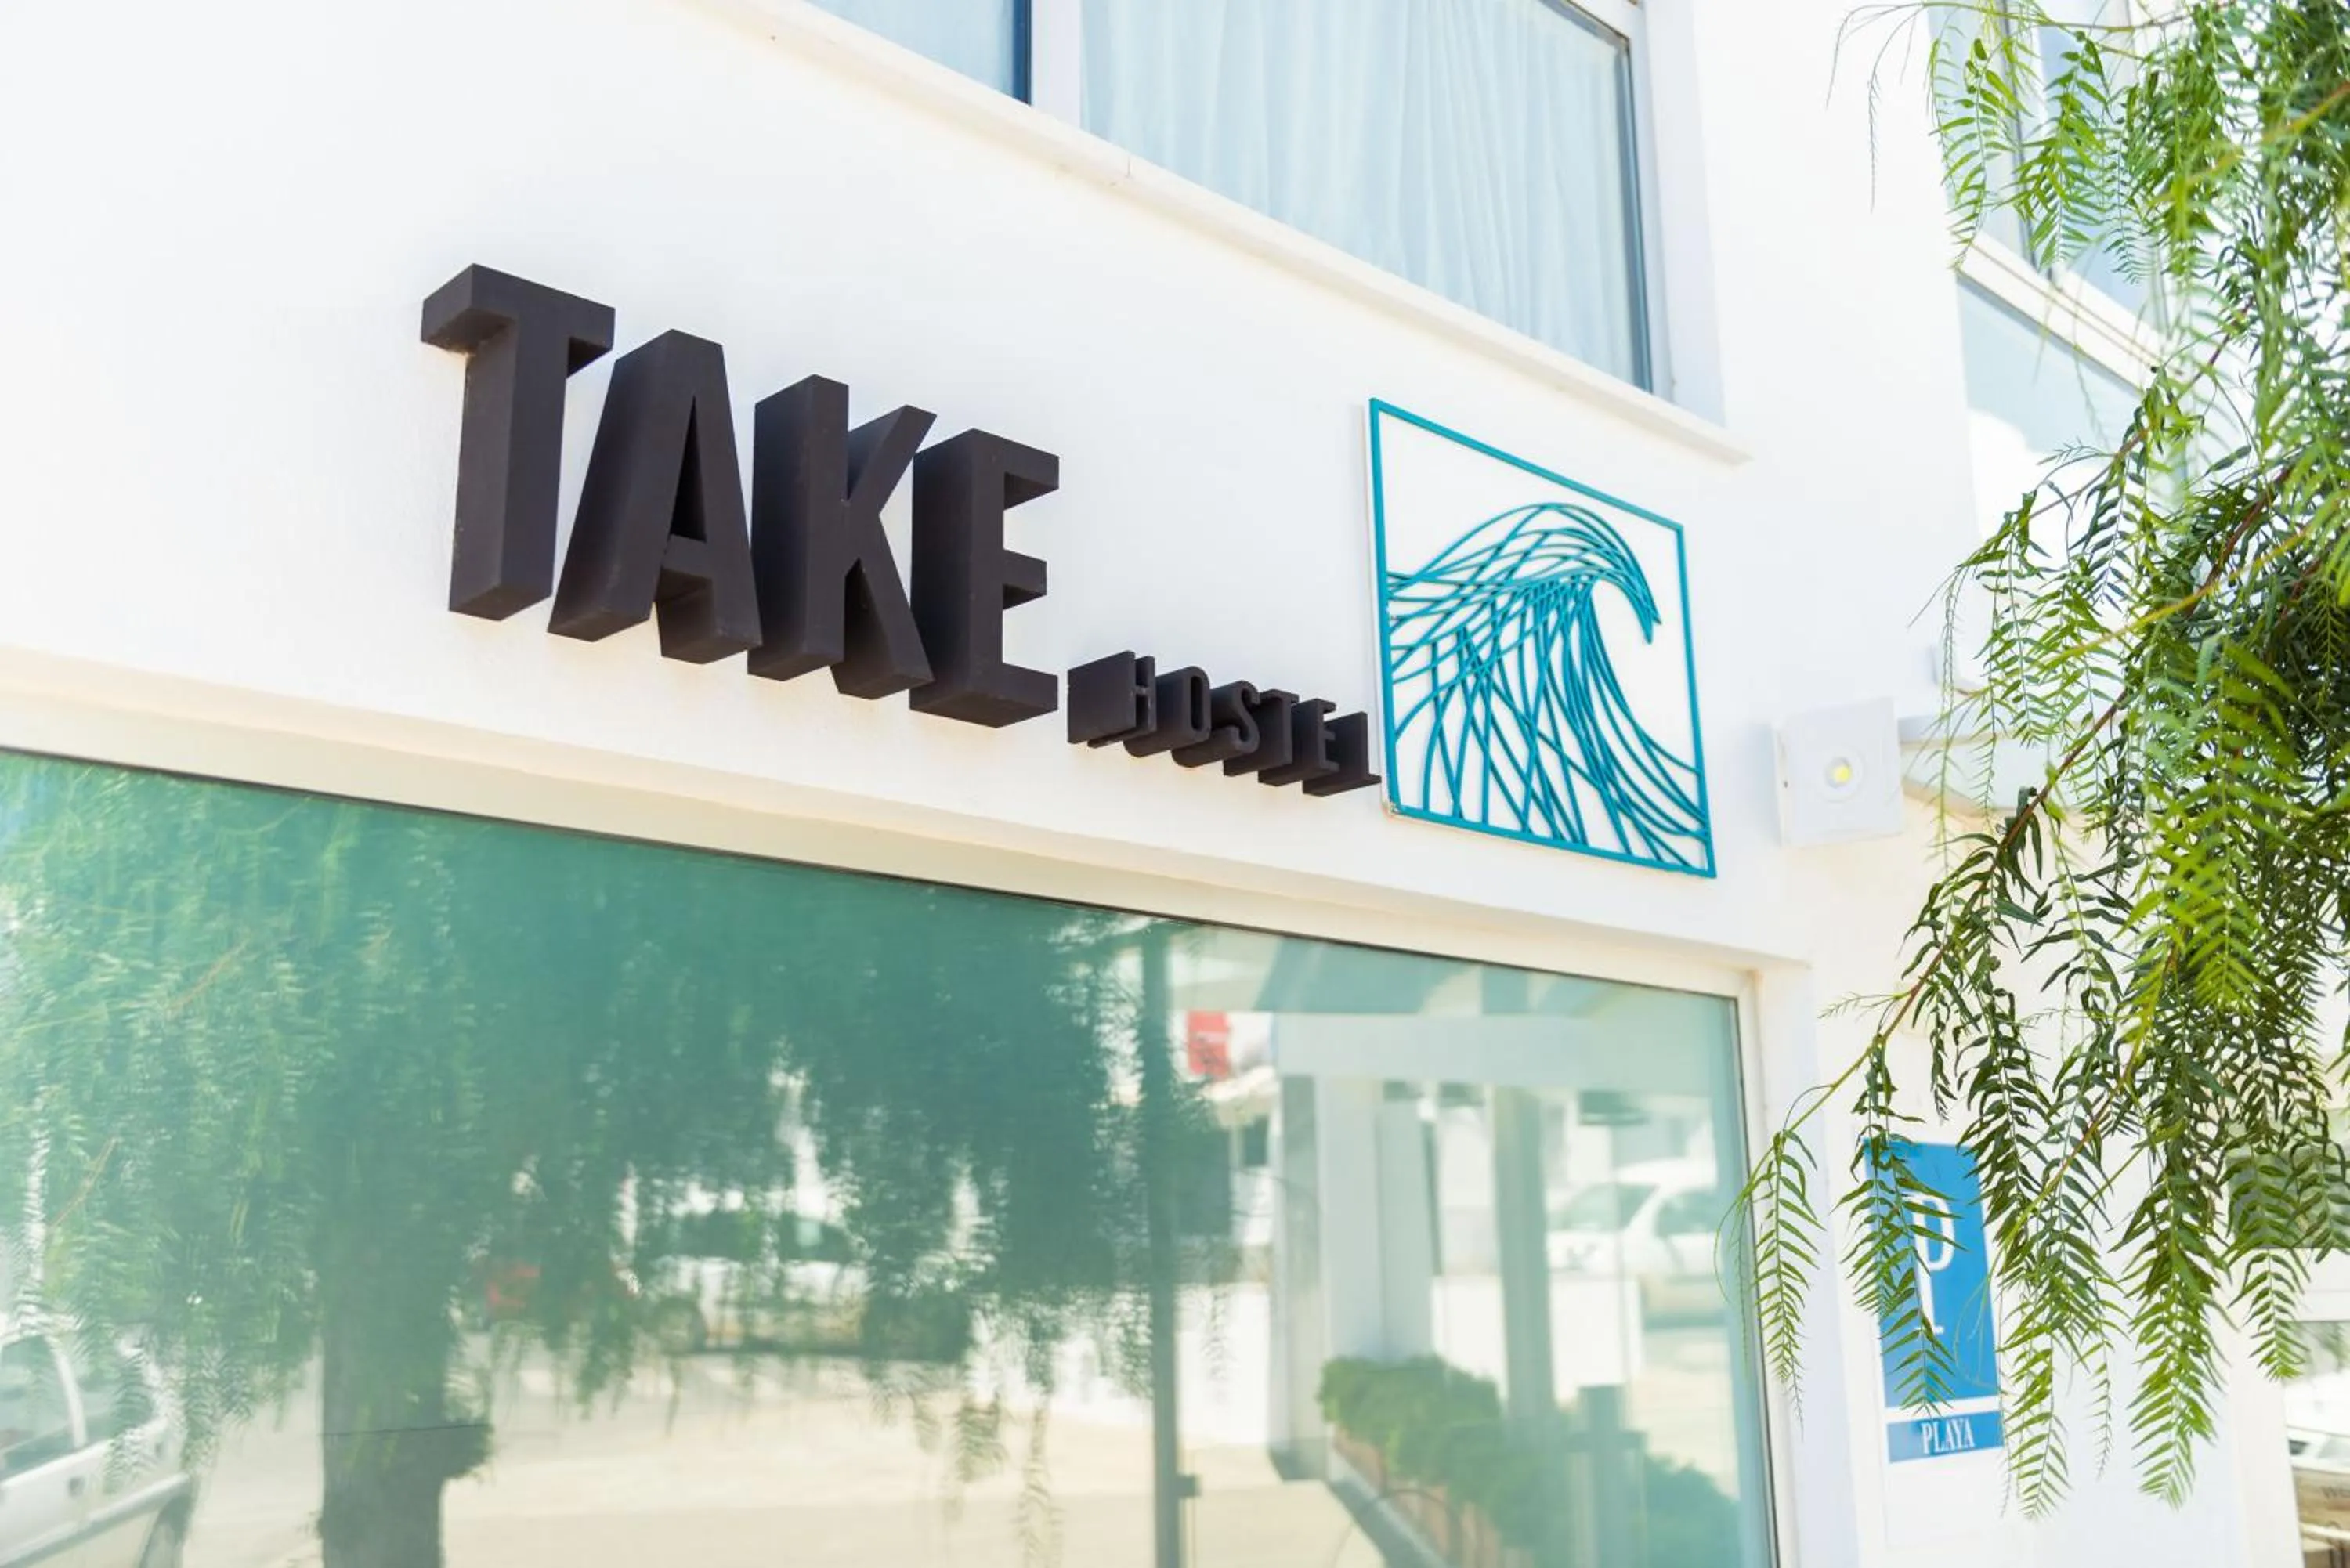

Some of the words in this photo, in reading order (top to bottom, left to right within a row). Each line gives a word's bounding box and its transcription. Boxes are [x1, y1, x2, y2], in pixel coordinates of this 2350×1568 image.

[421, 263, 1060, 728] TAKE
[1067, 650, 1382, 797] HOSTEL
[1921, 1418, 1976, 1454] PLAYA
